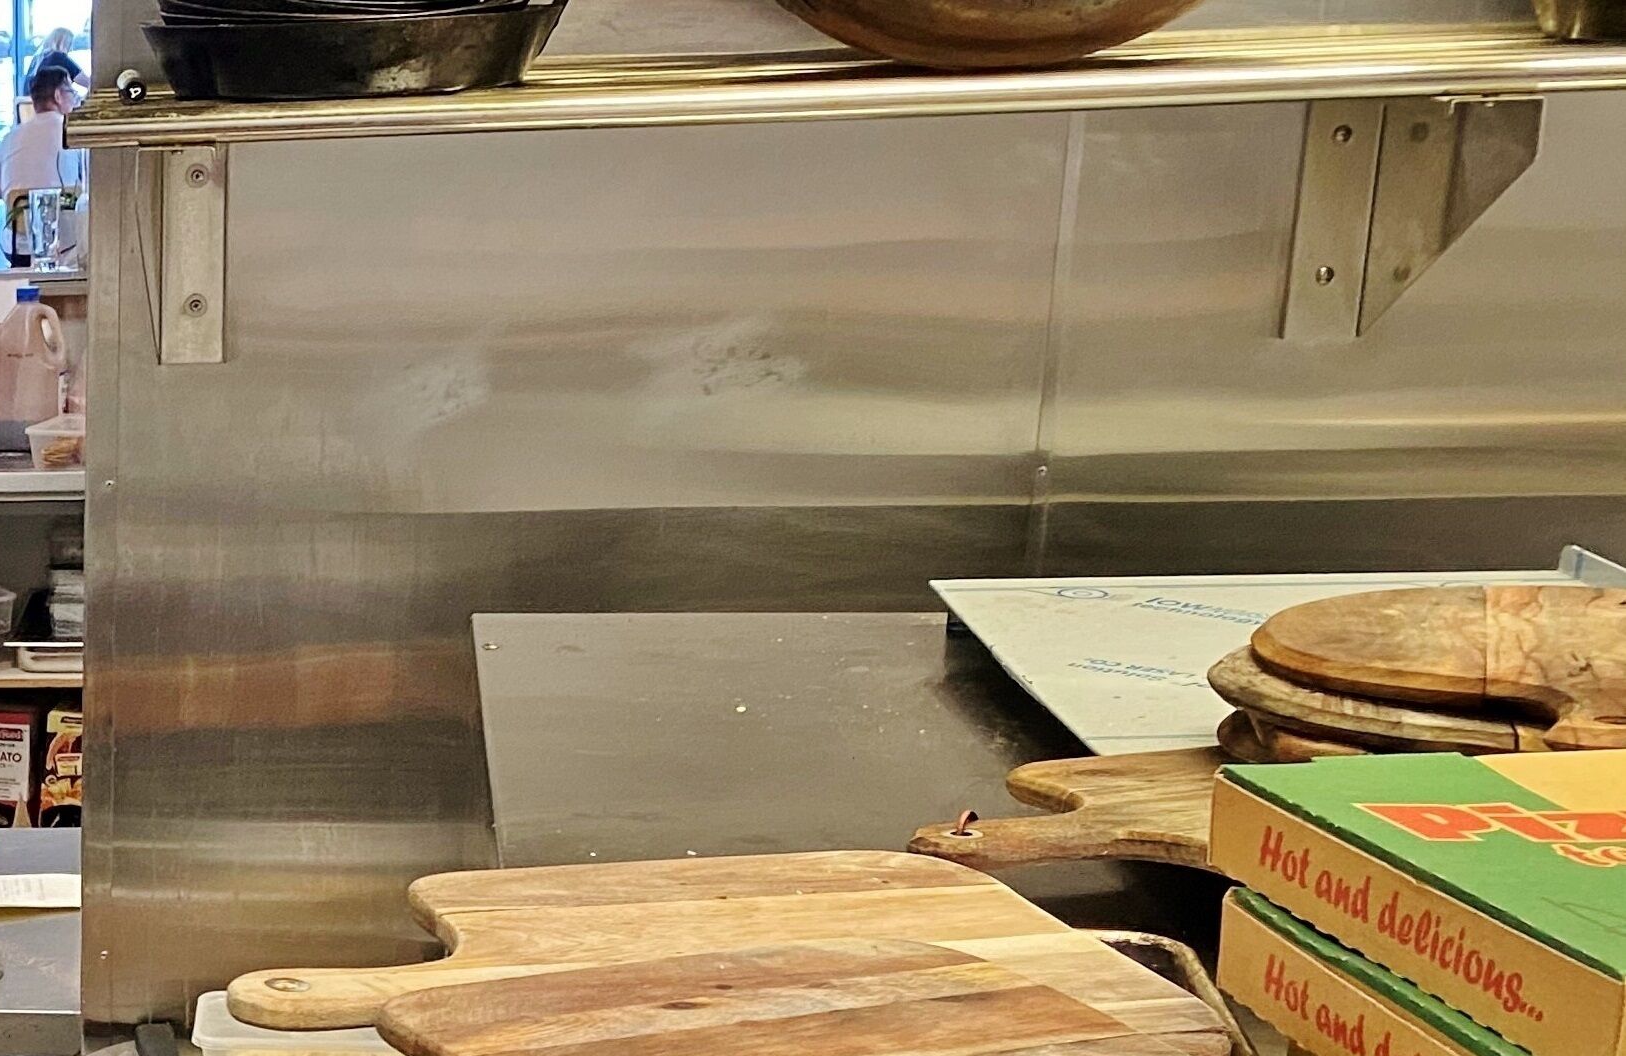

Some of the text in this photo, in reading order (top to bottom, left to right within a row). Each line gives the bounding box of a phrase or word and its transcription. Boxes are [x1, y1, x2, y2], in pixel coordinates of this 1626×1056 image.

[1259, 826, 1544, 1022] Hot and delicious...
[1264, 954, 1309, 1020] Hot
